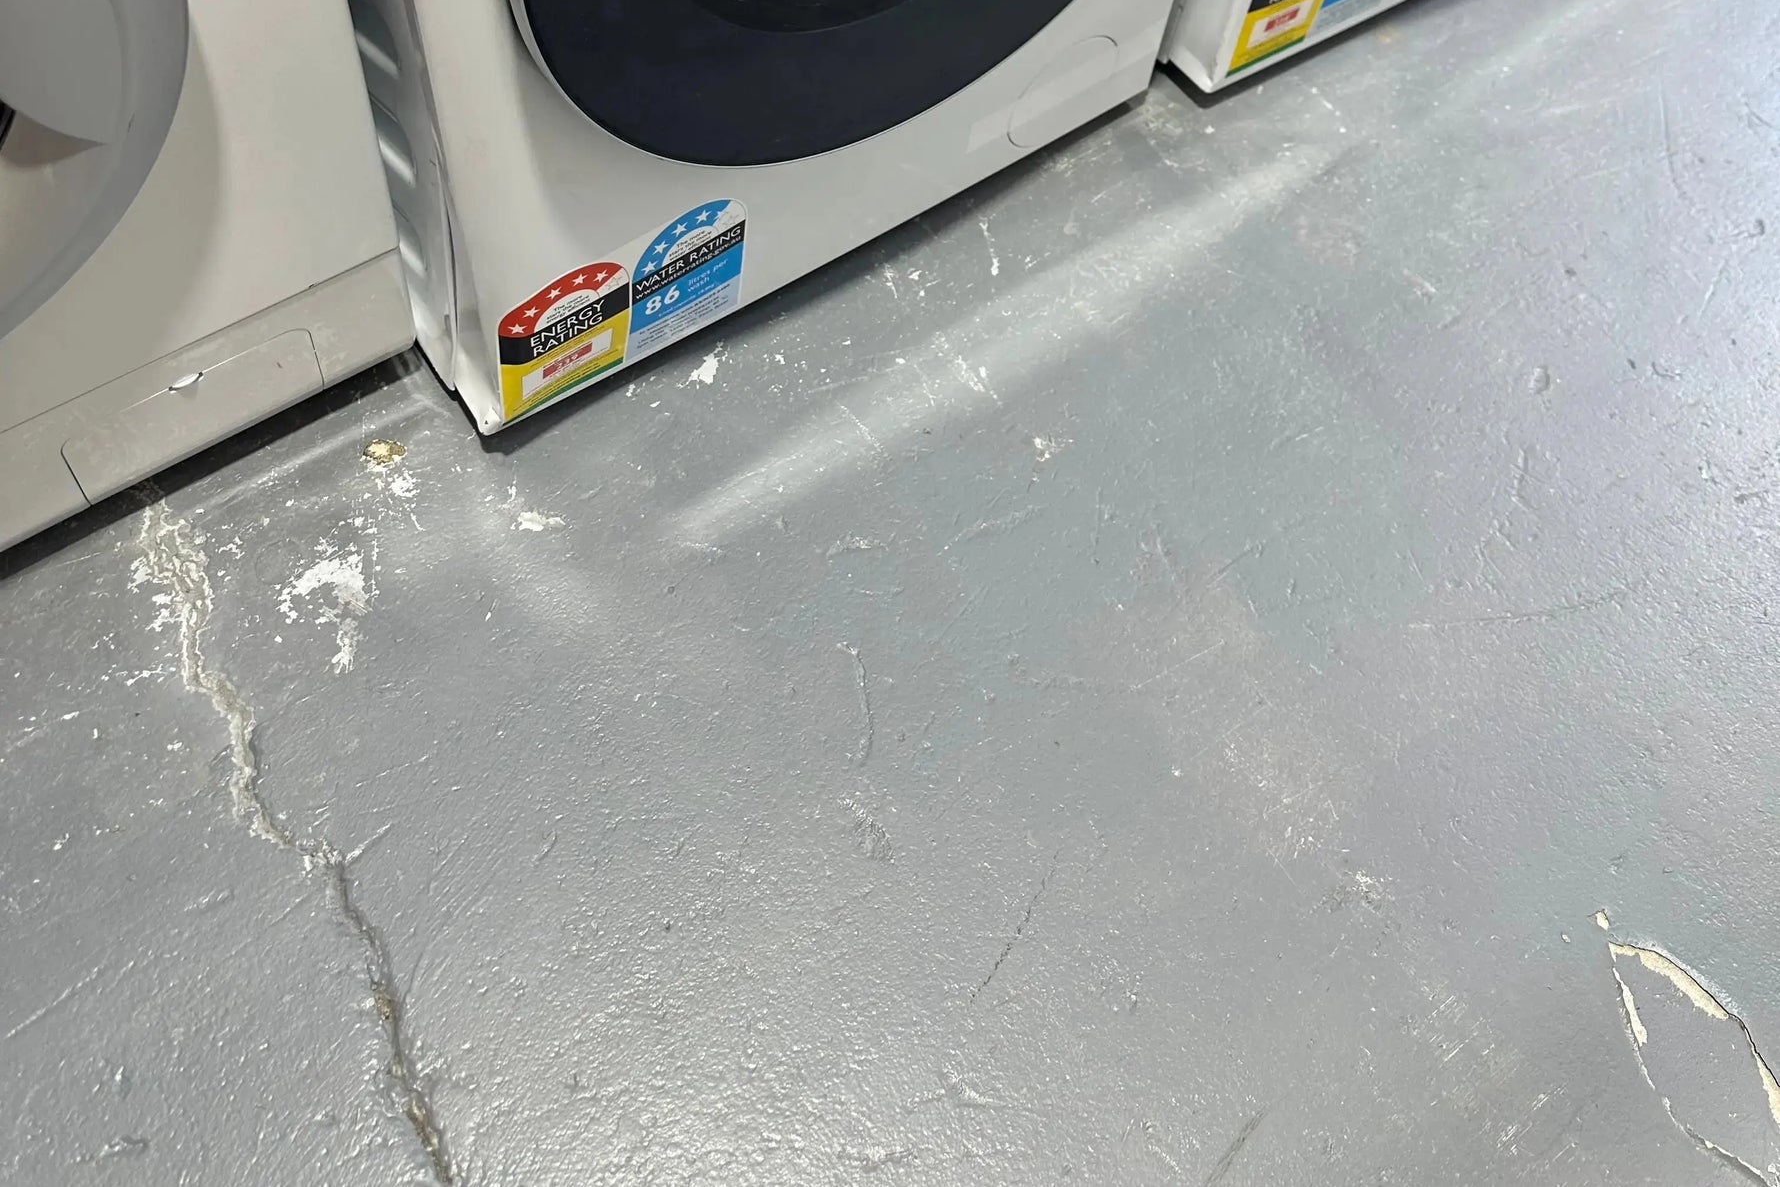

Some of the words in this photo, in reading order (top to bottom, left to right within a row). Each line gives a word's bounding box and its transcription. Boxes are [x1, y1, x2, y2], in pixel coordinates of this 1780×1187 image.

[636, 259, 685, 291] WATER
[689, 226, 741, 262] RATING
[713, 258, 729, 273] per
[645, 284, 680, 315] 86
[530, 299, 605, 347] ENERGY
[533, 312, 603, 357] RATING
